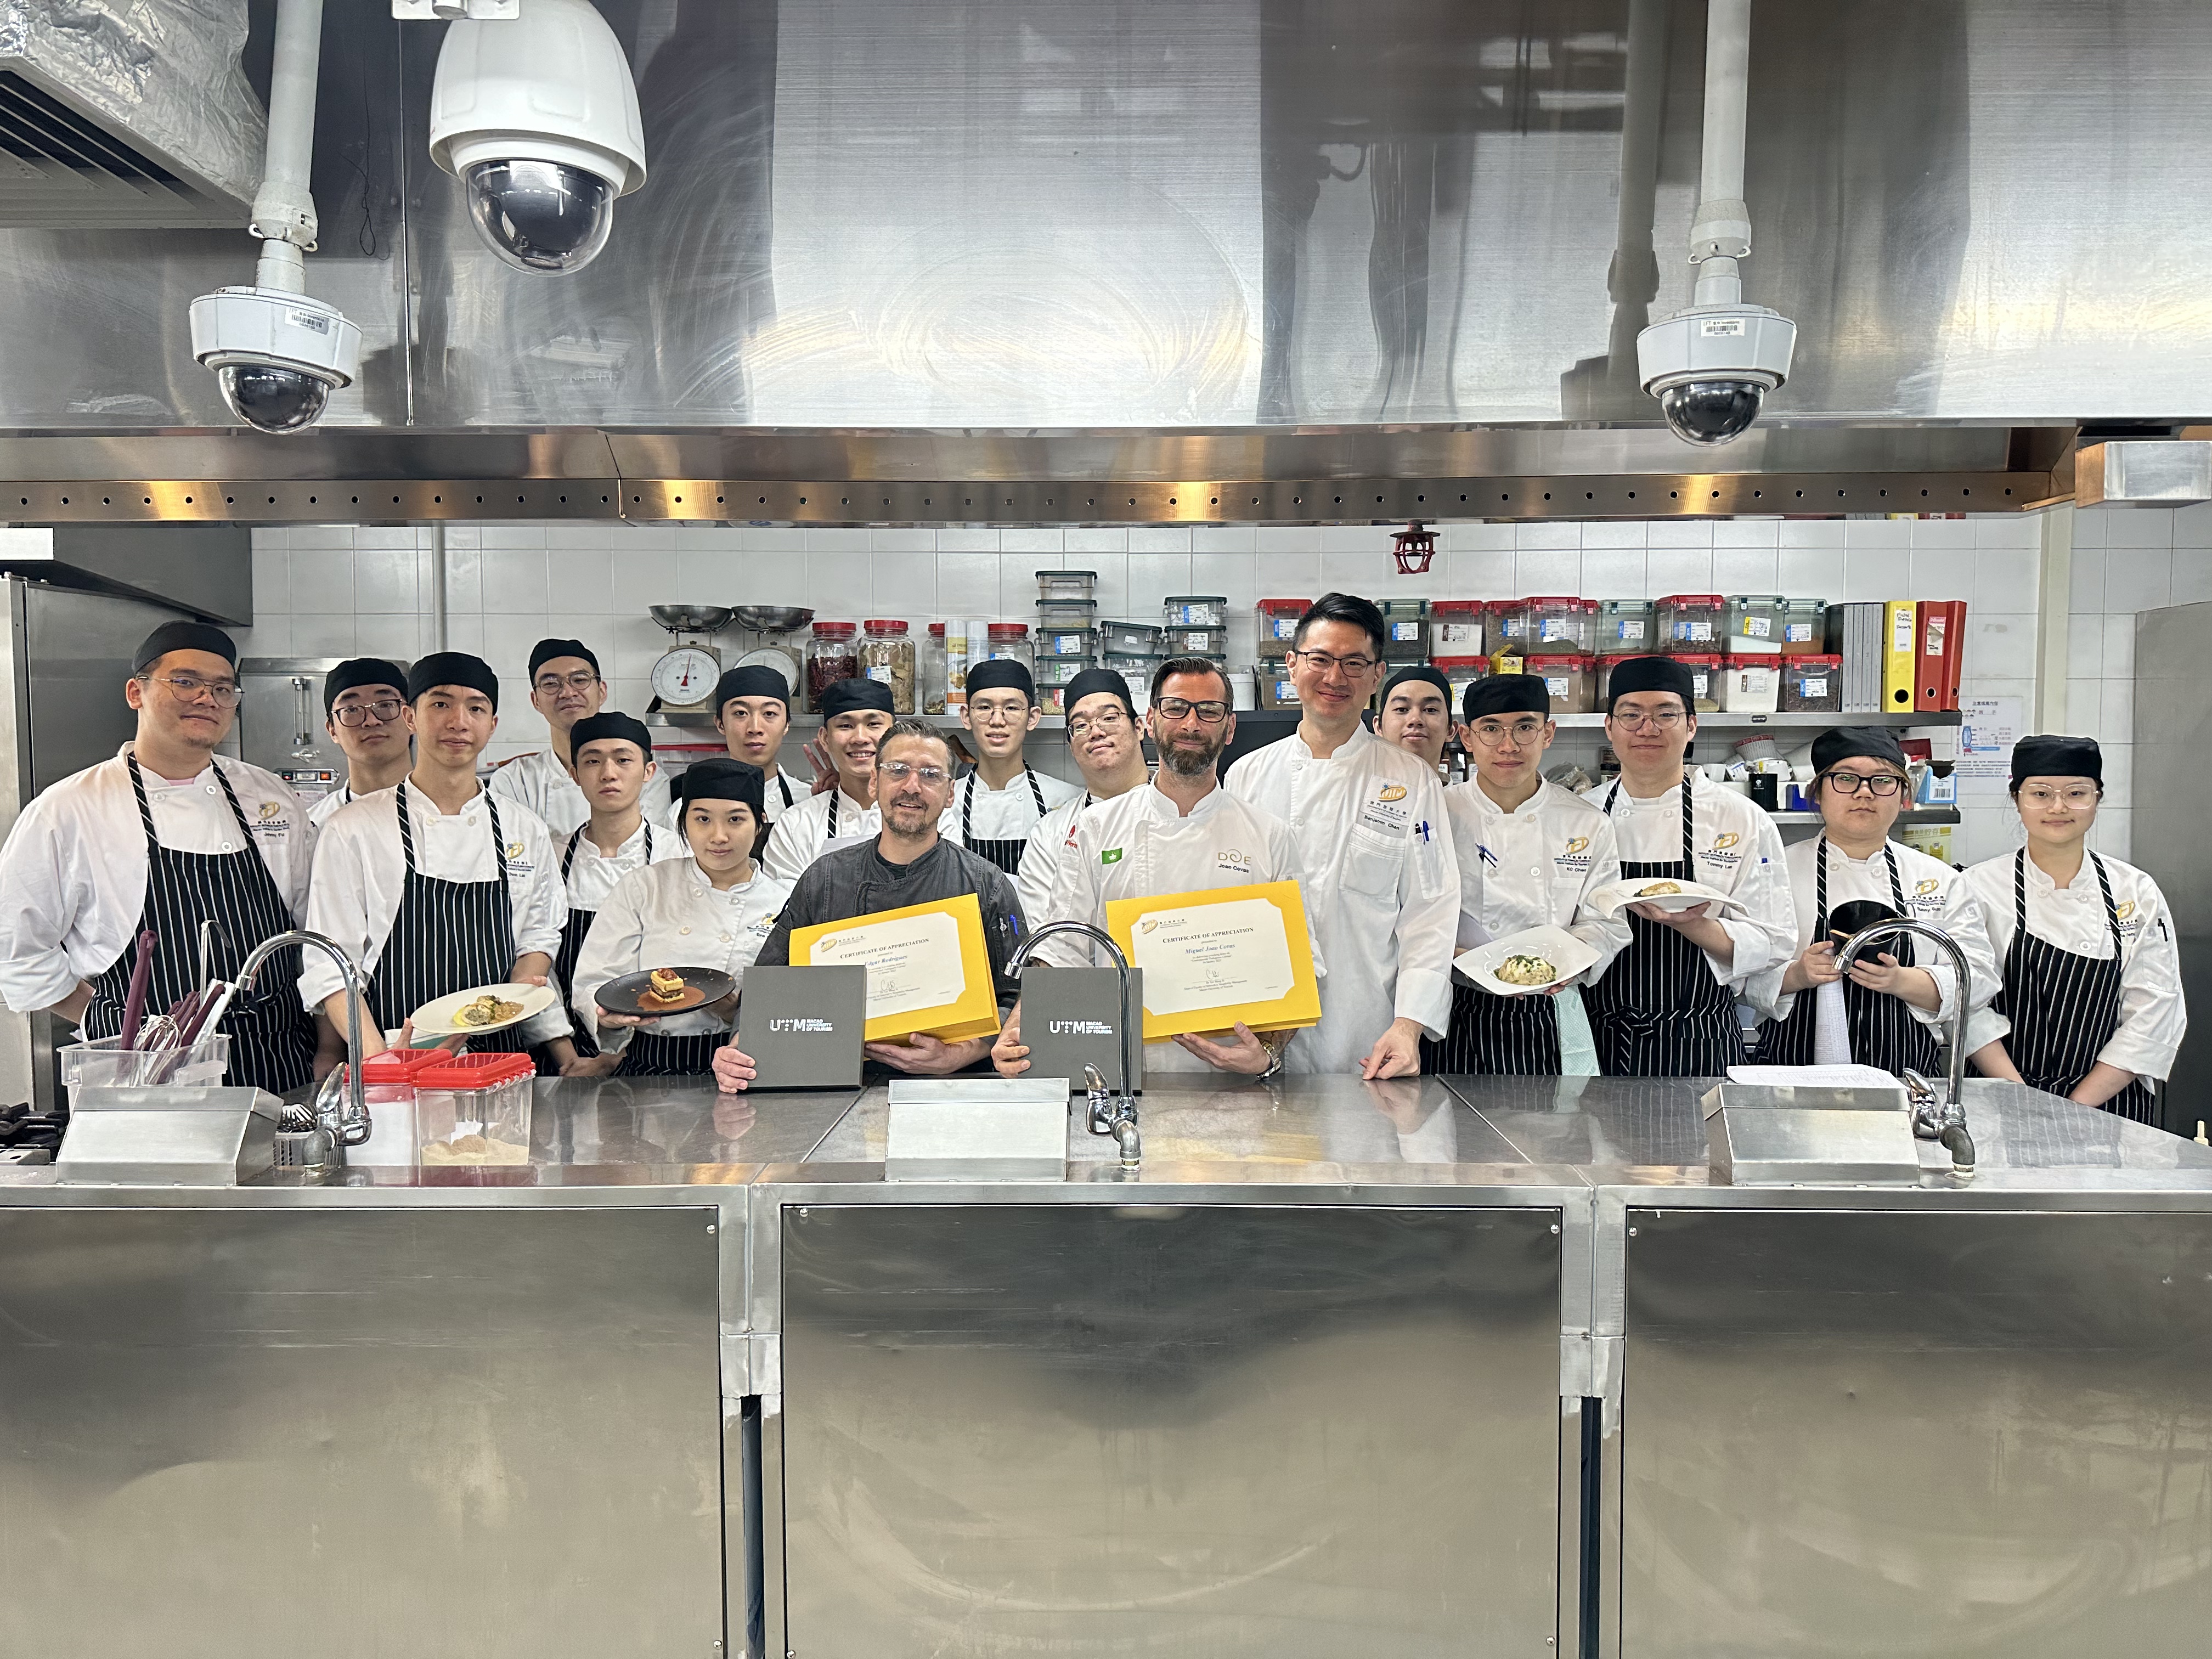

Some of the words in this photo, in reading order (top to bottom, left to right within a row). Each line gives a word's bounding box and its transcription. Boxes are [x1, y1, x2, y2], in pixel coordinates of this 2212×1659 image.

[1163, 934, 1201, 944] CERTIFICATE
[1211, 927, 1254, 937] APPRECIATION
[840, 947, 878, 959] CERTIFICATE
[888, 938, 929, 950] APPRECIATION
[882, 955, 908, 963] Rodrigues
[770, 1019, 806, 1031] UTM
[1049, 1020, 1086, 1034] UTM
